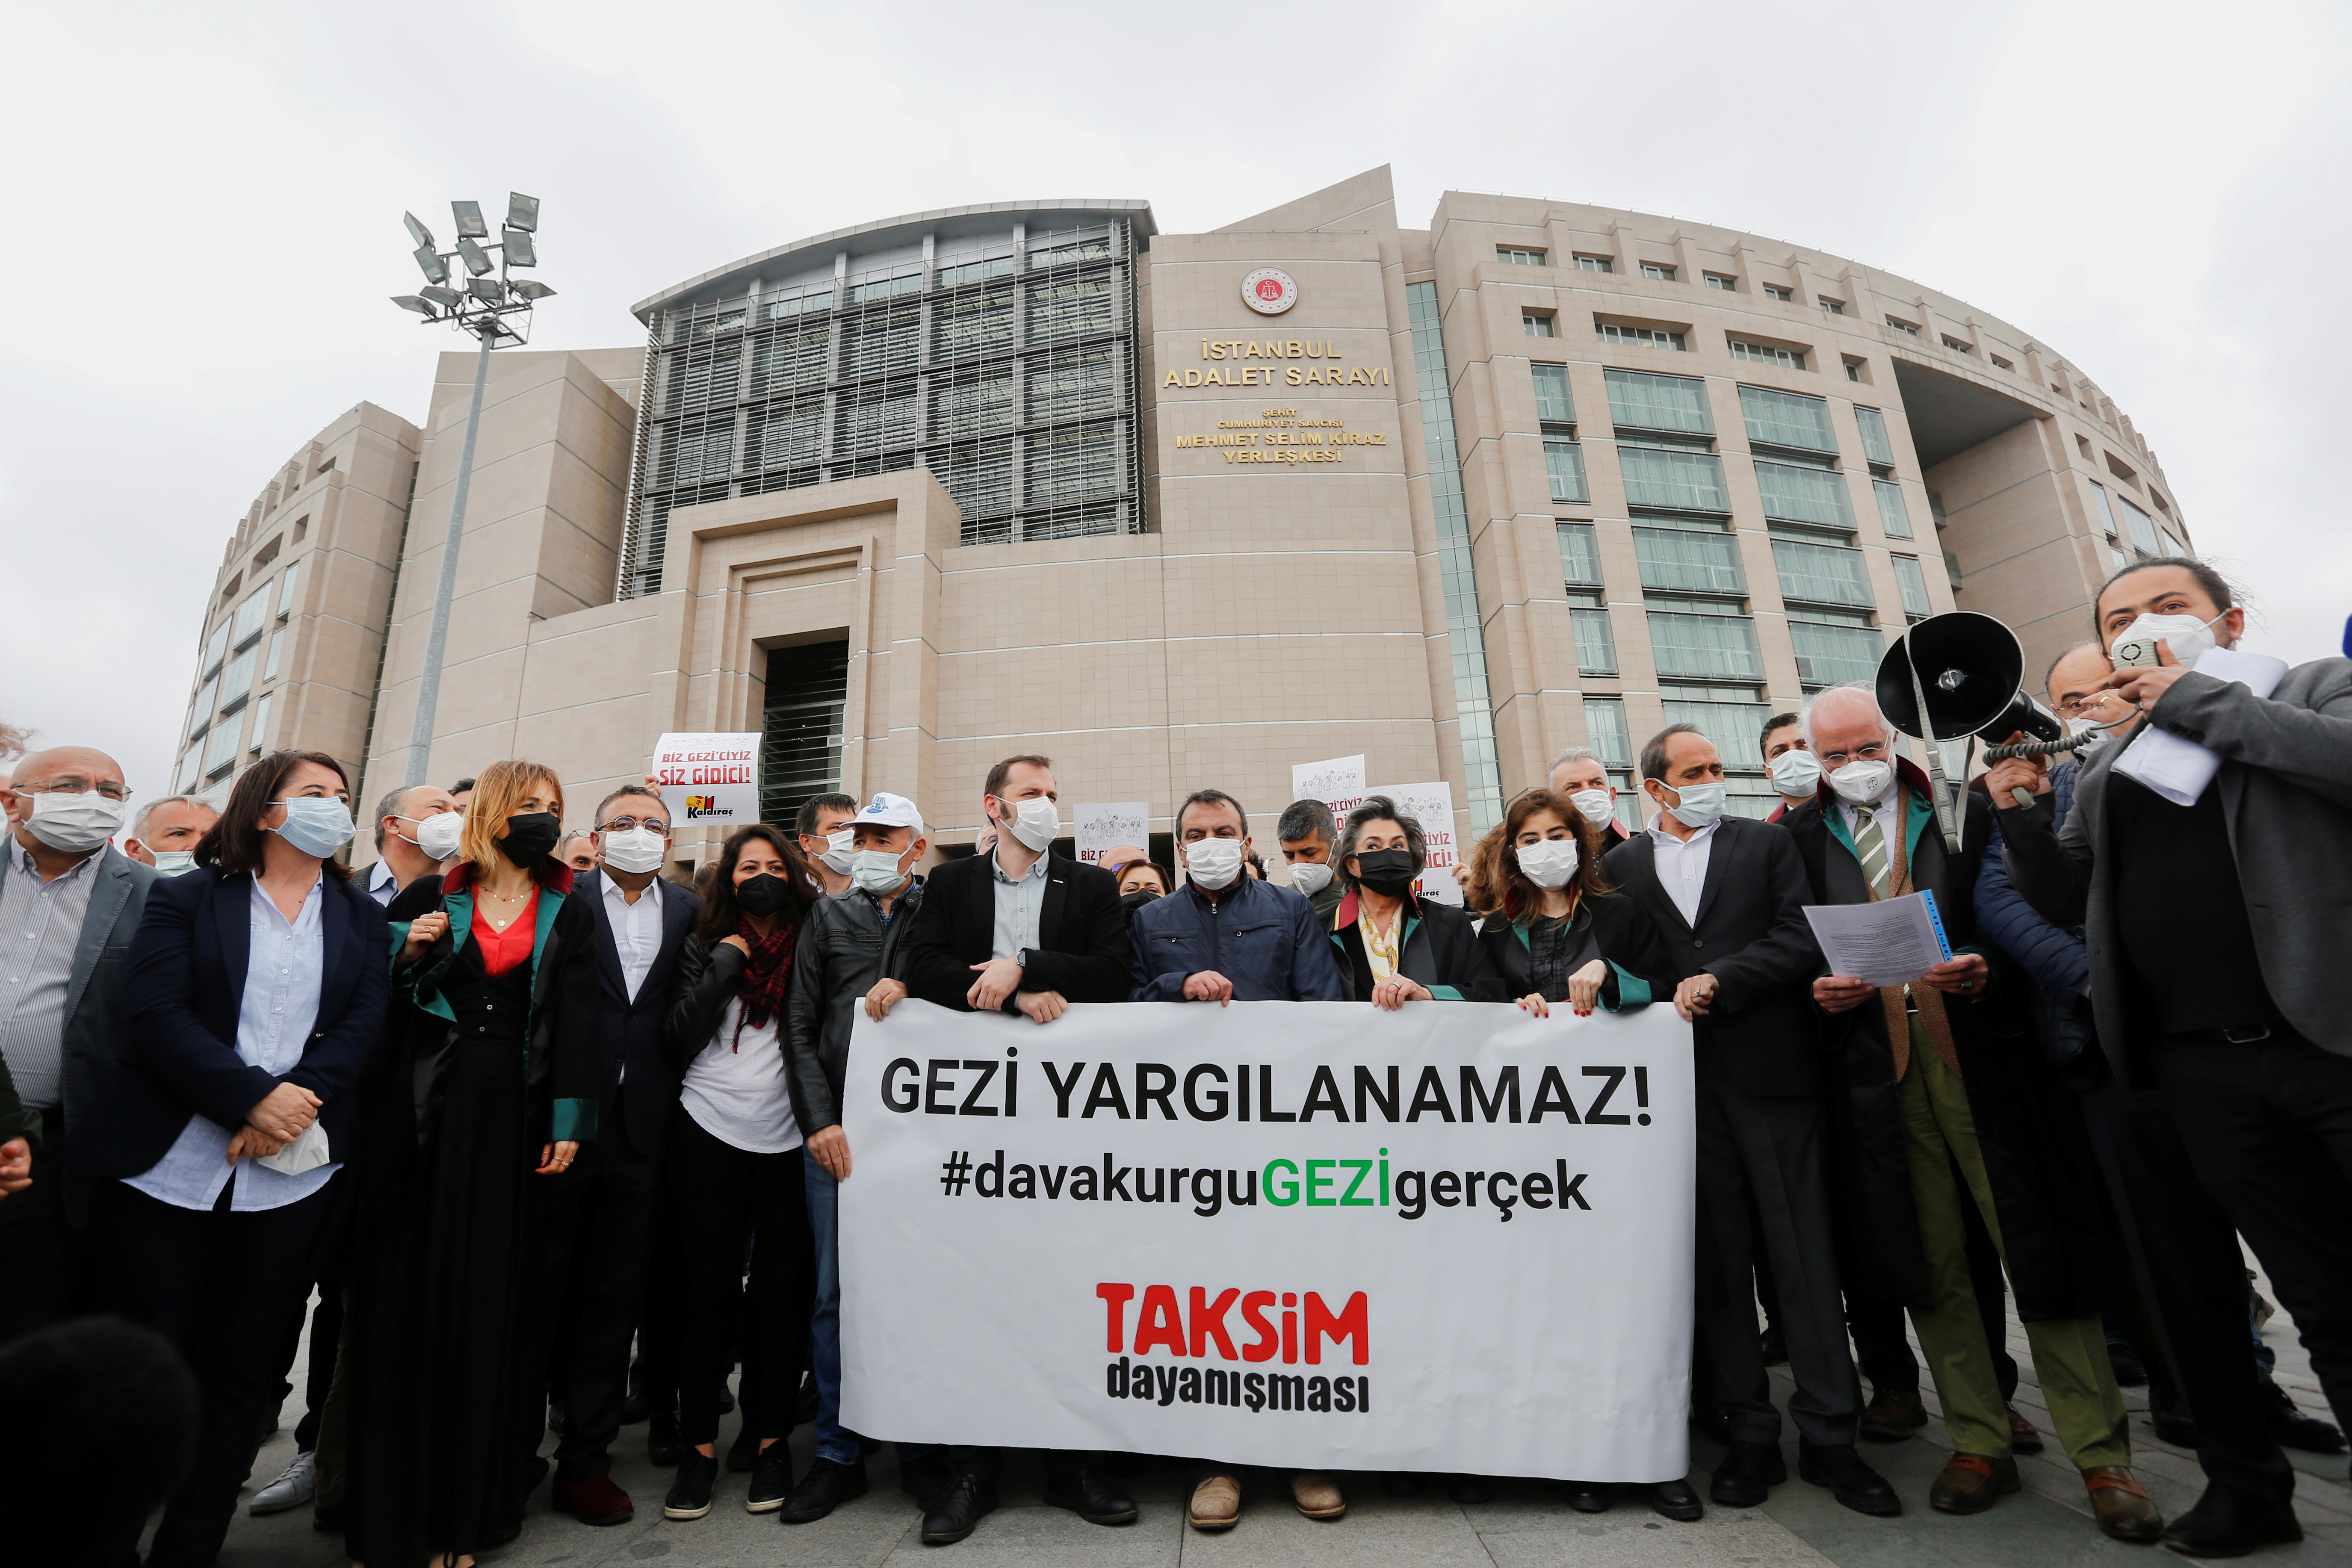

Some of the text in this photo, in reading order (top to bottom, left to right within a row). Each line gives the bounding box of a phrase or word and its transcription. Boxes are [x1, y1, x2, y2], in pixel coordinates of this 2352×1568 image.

[1202, 338, 1342, 360] İSTANBUL
[1163, 366, 1389, 388] ADALET SARAYI
[1217, 418, 1343, 429] CUMHURİYET SAVCISI
[1262, 408, 1297, 418] ŞEHİT
[1176, 430, 1386, 449] MEHMET SELİM KİRAZ
[1223, 447, 1342, 465] YERLEŞKESİ
[663, 752, 683, 762] BİZ
[660, 764, 750, 785] SİZ GİDİCİ!
[687, 796, 733, 818] Kaldıraç
[1081, 848, 1096, 860] BİZ
[881, 1047, 1651, 1126] GEZİ YARGILANAMAZ!
[940, 1148, 1592, 1223] #davakurguGEZİgerçek
[1107, 1356, 1369, 1413] dayanışması
